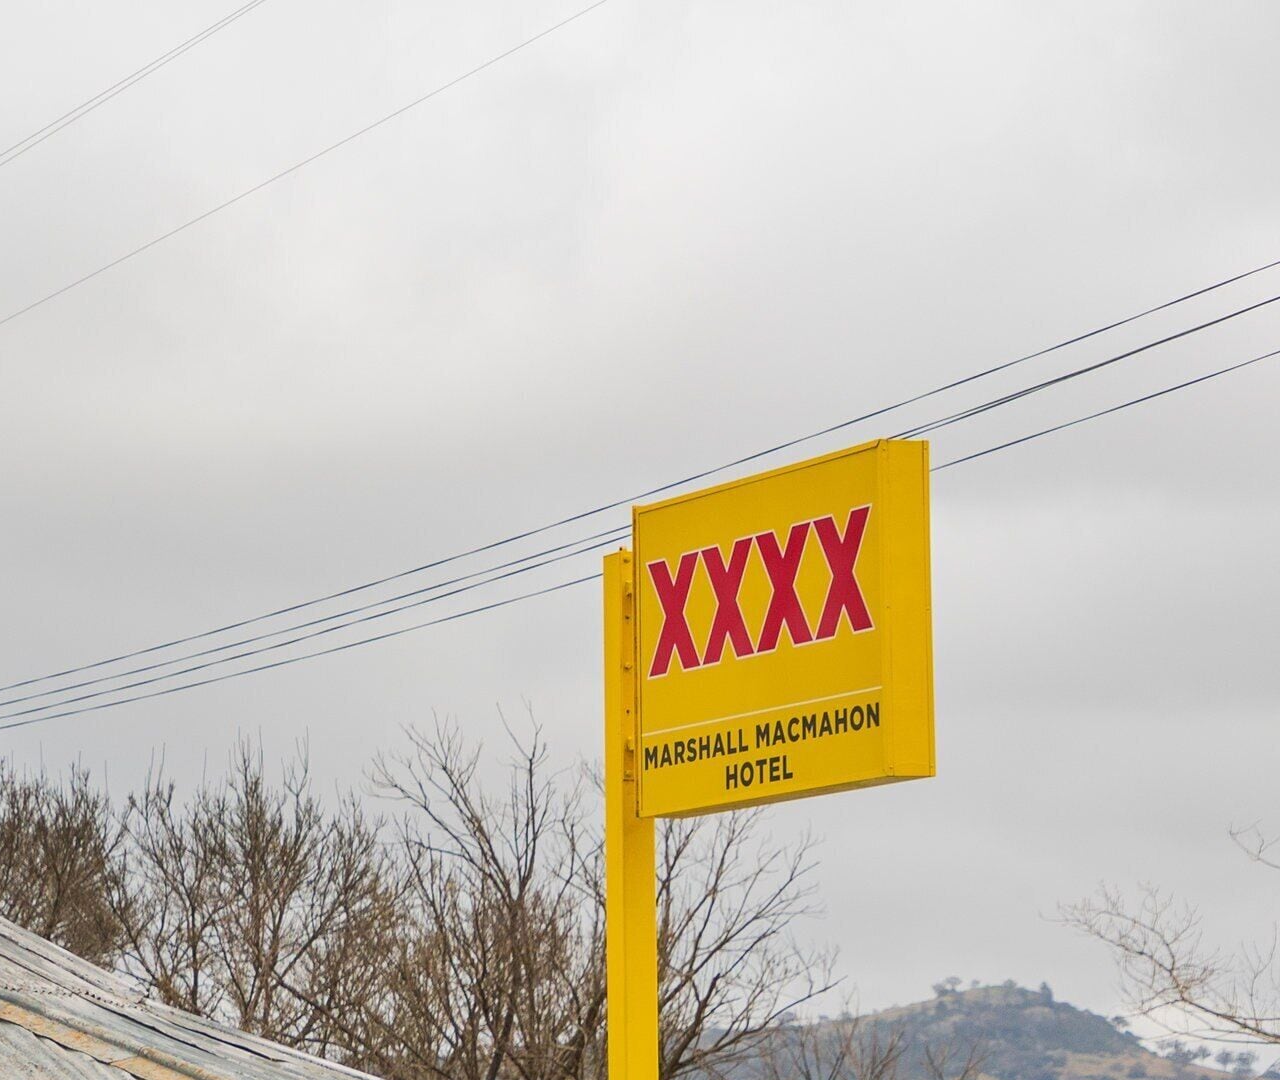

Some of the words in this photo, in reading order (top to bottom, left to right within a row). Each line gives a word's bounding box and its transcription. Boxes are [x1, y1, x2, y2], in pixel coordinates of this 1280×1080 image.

[646, 505, 874, 680] XXXX
[644, 729, 749, 771] MARSHALL
[755, 702, 881, 749] MACMAHON
[725, 755, 794, 790] HOTEL
